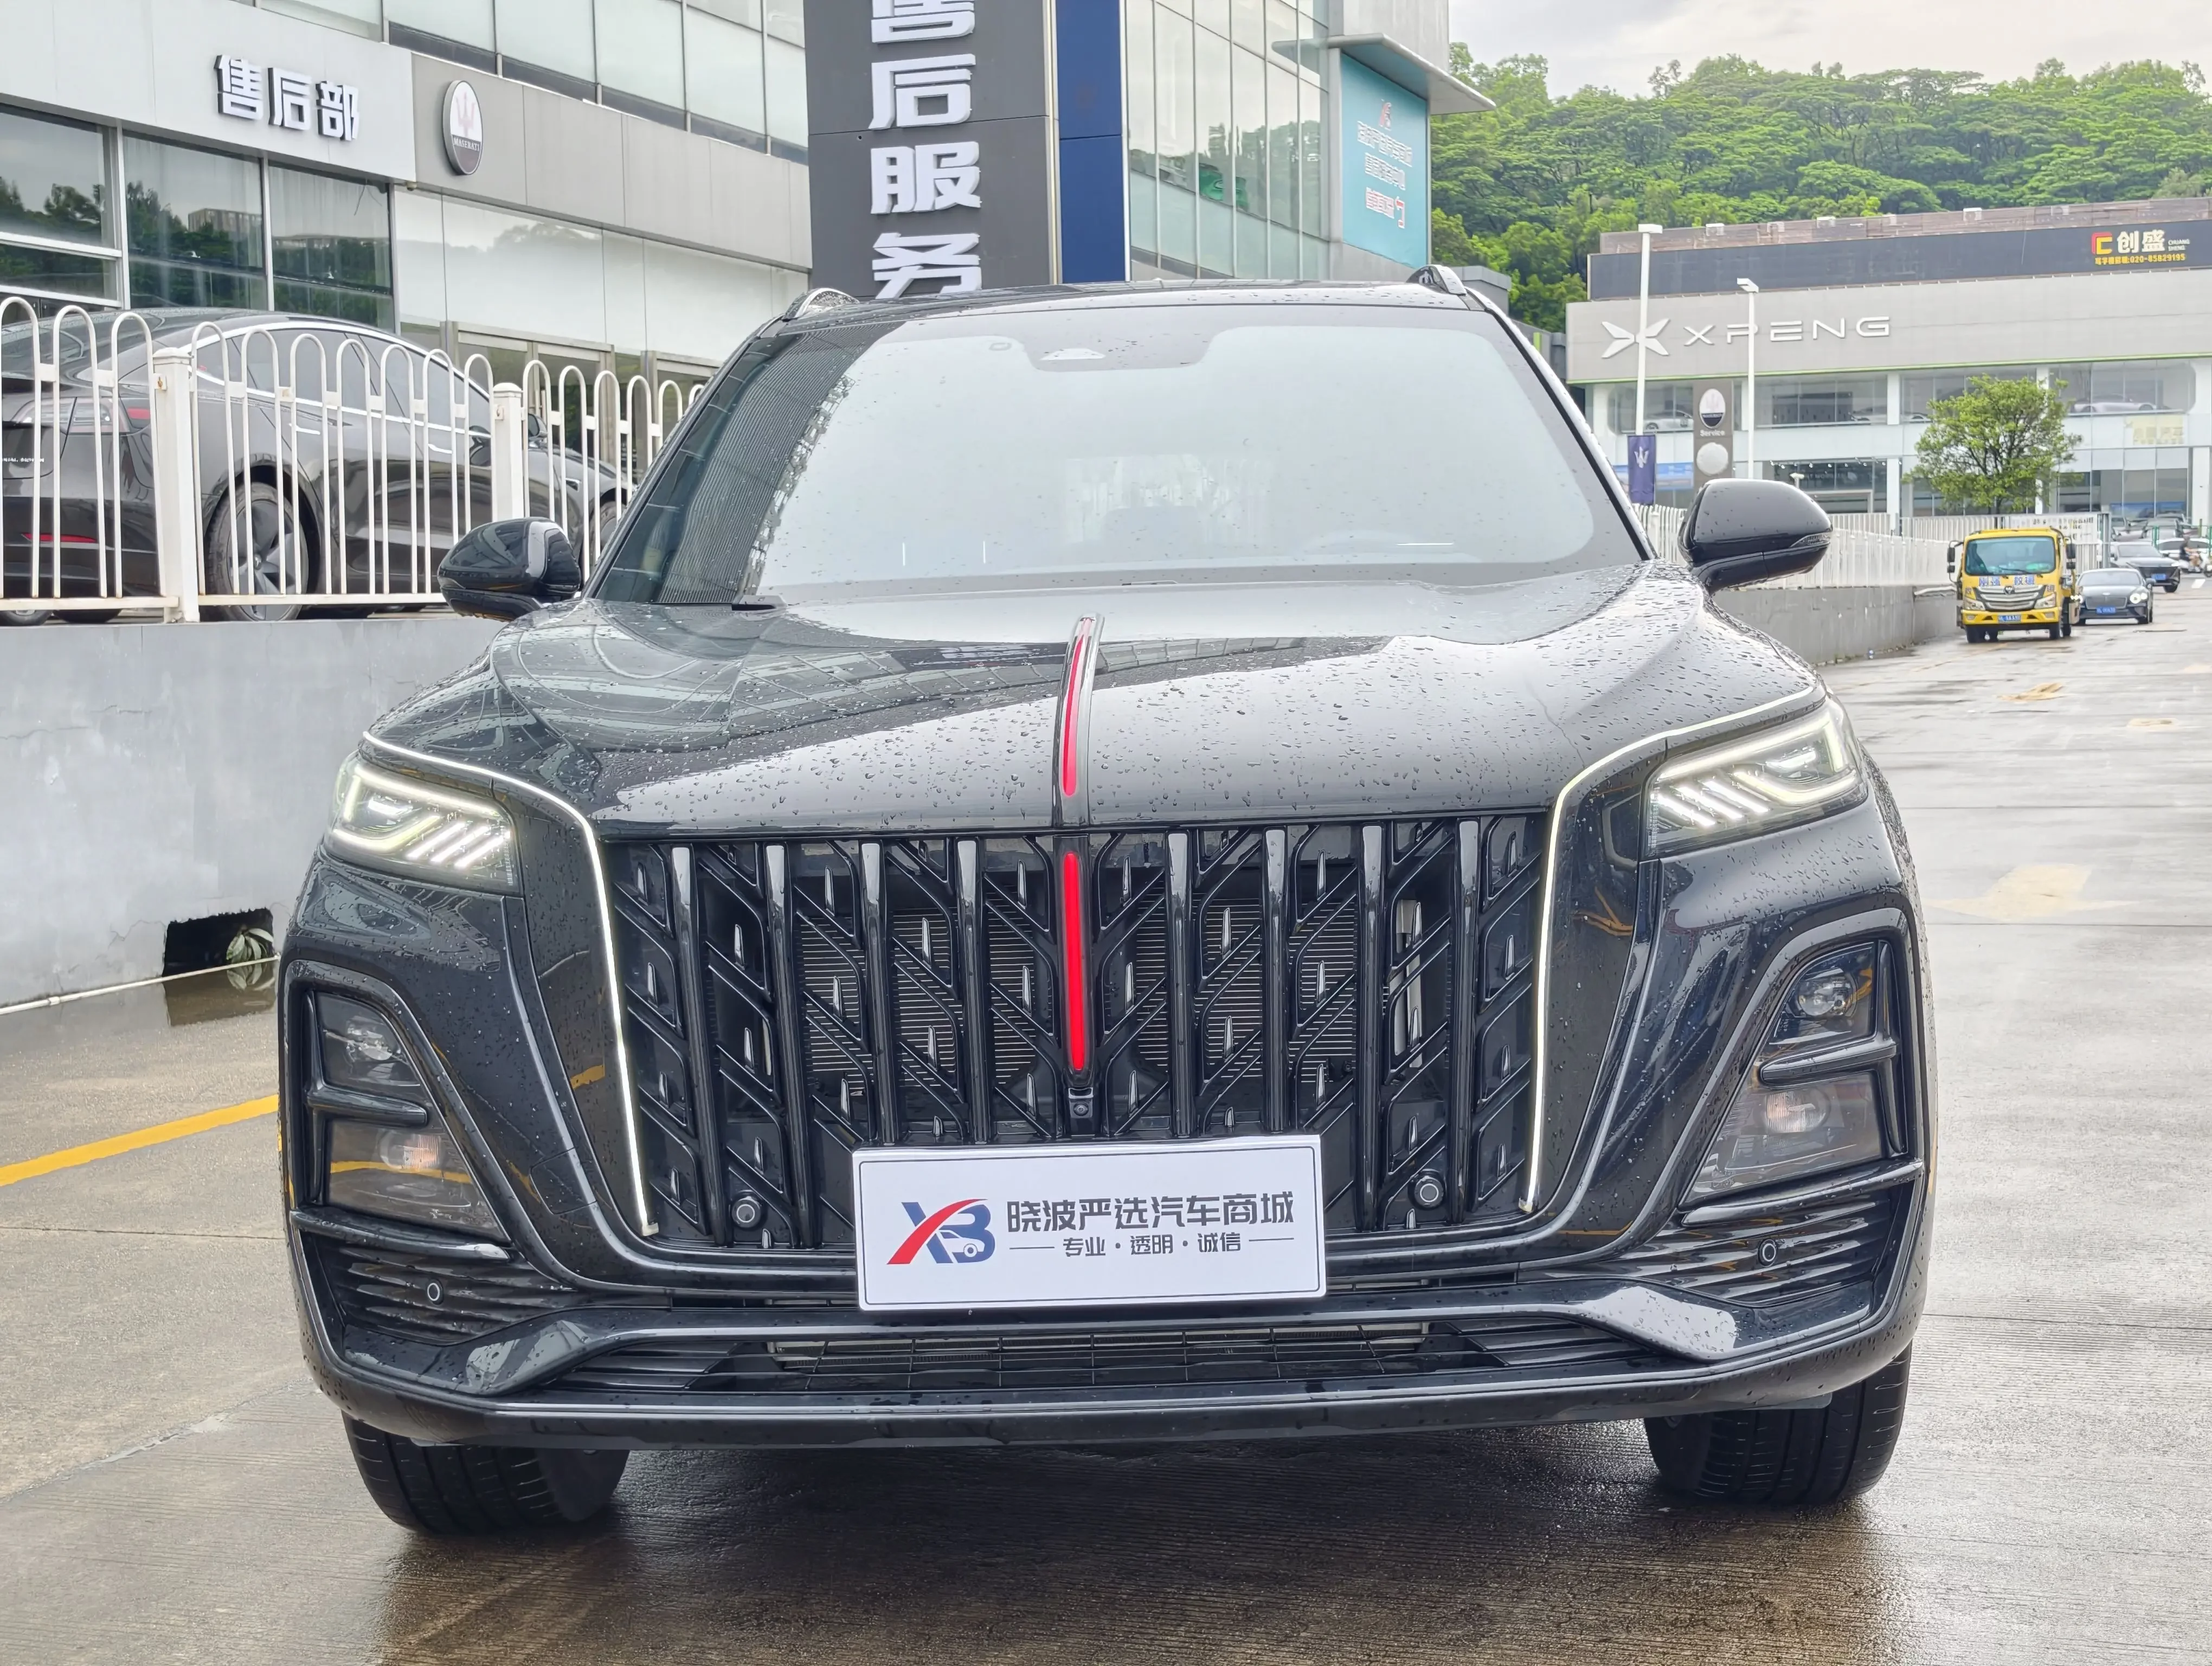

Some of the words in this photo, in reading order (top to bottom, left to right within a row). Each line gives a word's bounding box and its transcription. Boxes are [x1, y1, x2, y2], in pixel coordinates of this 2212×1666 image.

[214, 54, 359, 141] 售后部
[454, 137, 480, 151] MASERATI
[2117, 229, 2165, 253] 创盛
[1684, 316, 1890, 345] XPENG
[1007, 1191, 1294, 1233] 晓波严选汽车商城
